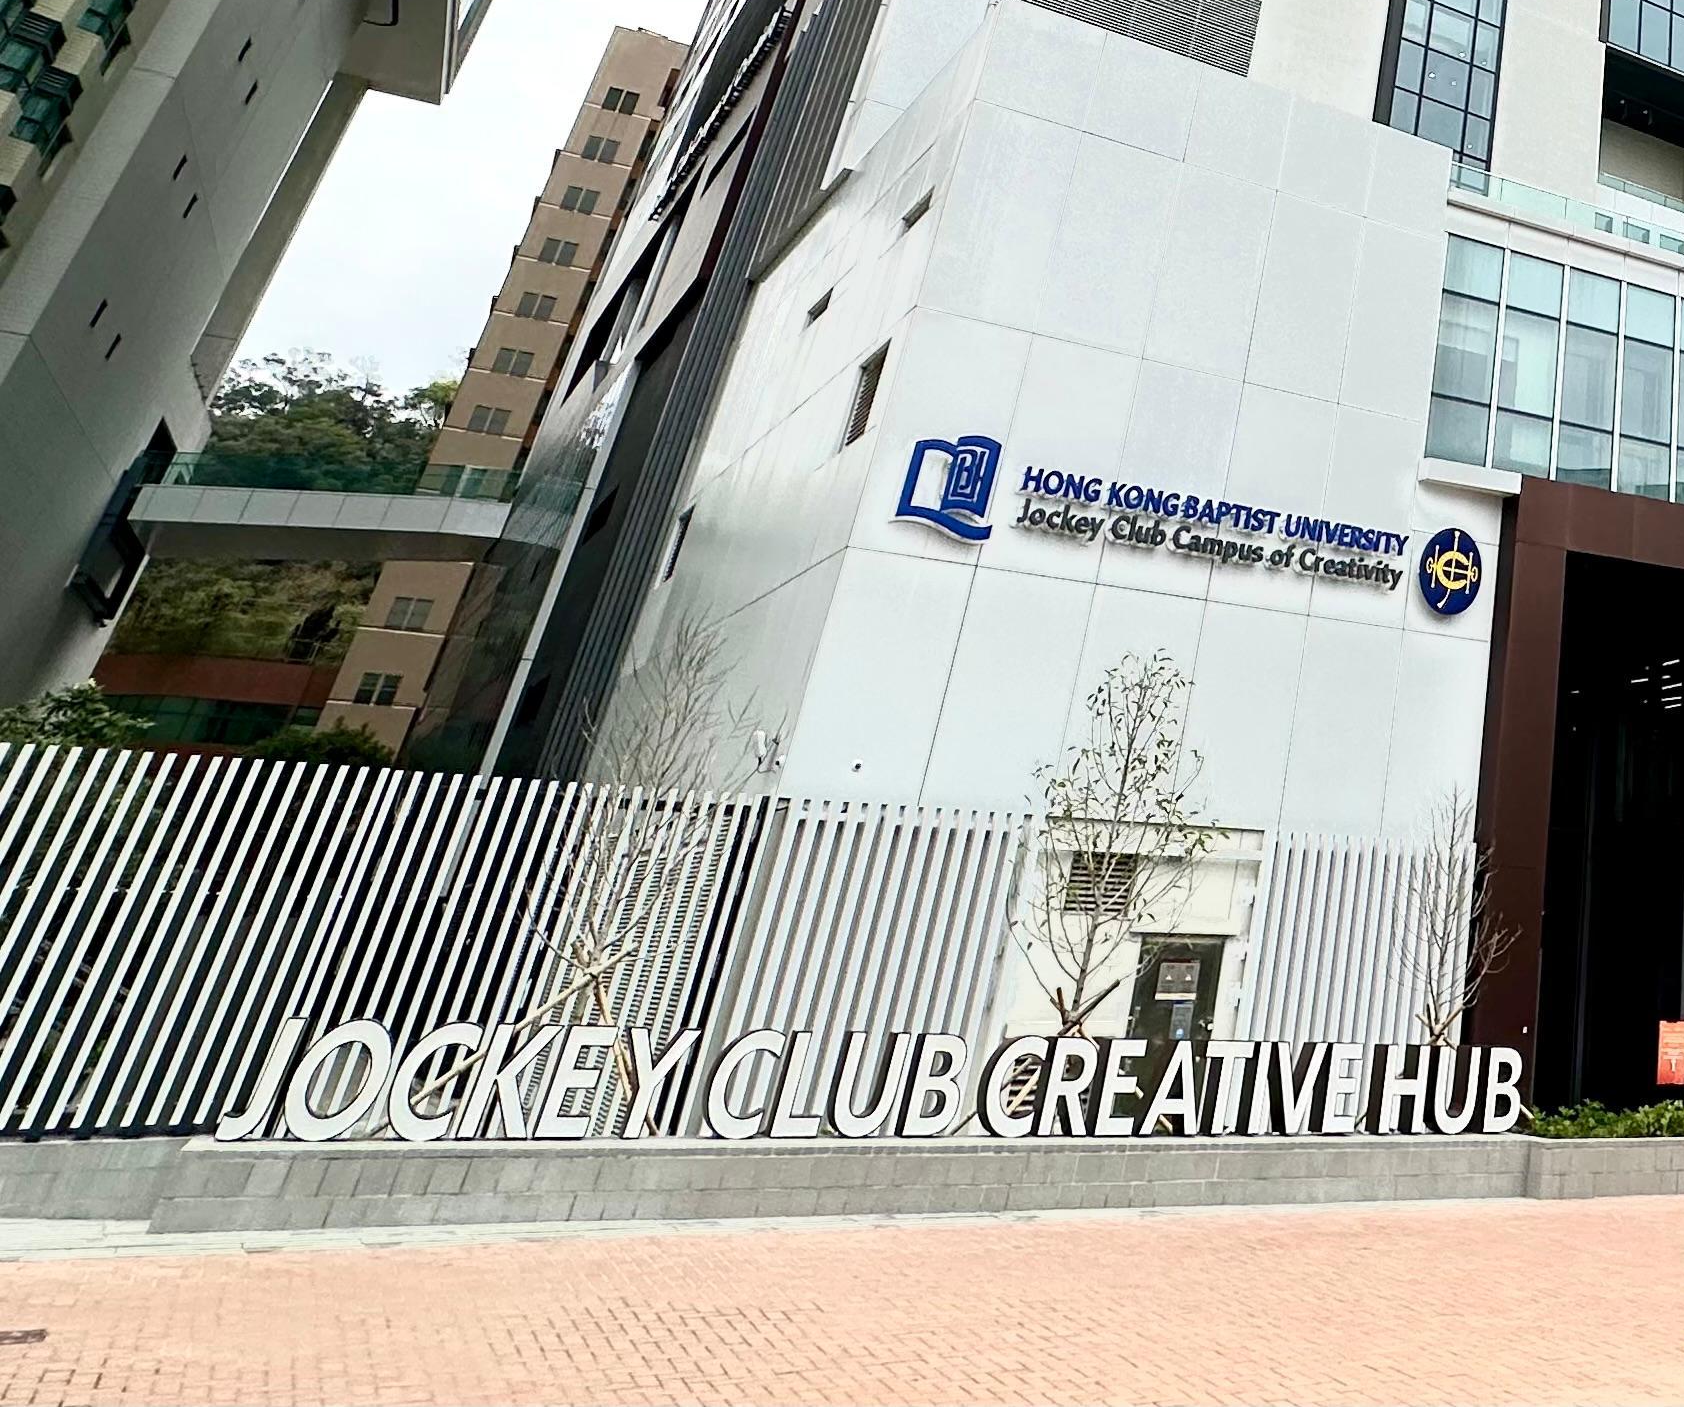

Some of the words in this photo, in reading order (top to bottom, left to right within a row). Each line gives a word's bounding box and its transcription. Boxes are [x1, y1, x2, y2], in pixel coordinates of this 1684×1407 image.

[1016, 498, 1105, 541] Jockey
[1111, 515, 1167, 546] Club
[1172, 525, 1264, 563] Campus
[1269, 544, 1297, 568] of
[1299, 547, 1403, 591] Creativity
[1020, 466, 1102, 502] HONG
[1107, 481, 1181, 517] KONG
[1181, 495, 1281, 534] BAPTIST
[1283, 513, 1410, 556] UNIVERSITY
[214, 1015, 702, 1143] JOCKEY
[704, 1029, 969, 1140] CLUB
[978, 1035, 1365, 1138] CREATIVE
[1372, 1044, 1525, 1136] HUB
